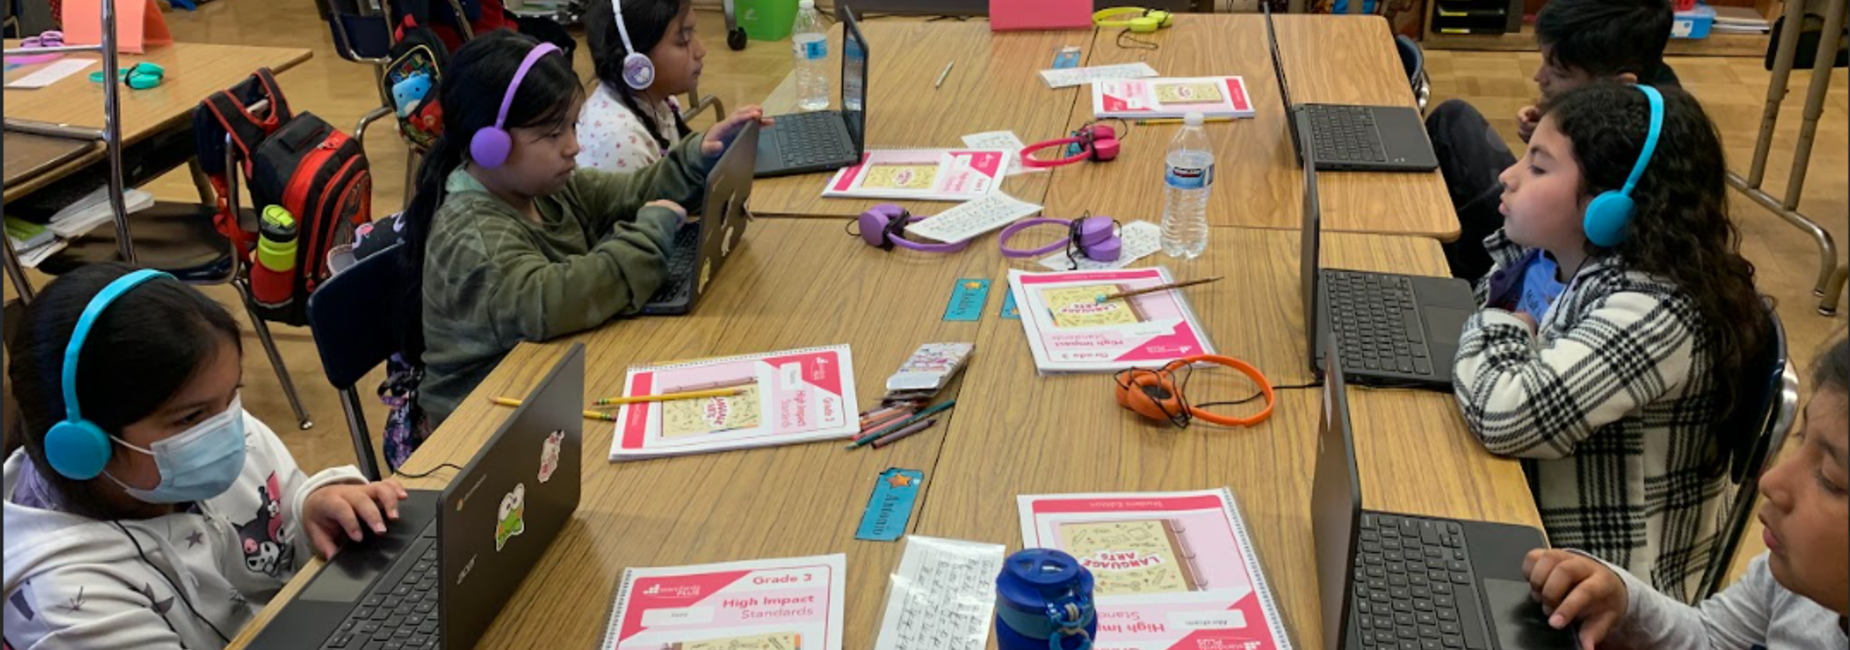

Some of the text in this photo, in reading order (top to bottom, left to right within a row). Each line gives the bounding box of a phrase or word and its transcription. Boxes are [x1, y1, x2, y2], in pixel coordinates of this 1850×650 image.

[793, 390, 806, 404] High
[823, 397, 834, 417] Grade
[796, 405, 807, 427] Impact
[1083, 556, 1161, 570] LANGUAGE
[1101, 552, 1136, 561] ARTS
[752, 572, 813, 586] Grade 3
[722, 595, 815, 609] High Impact
[741, 606, 814, 620] Standards
[1126, 621, 1165, 633] High
